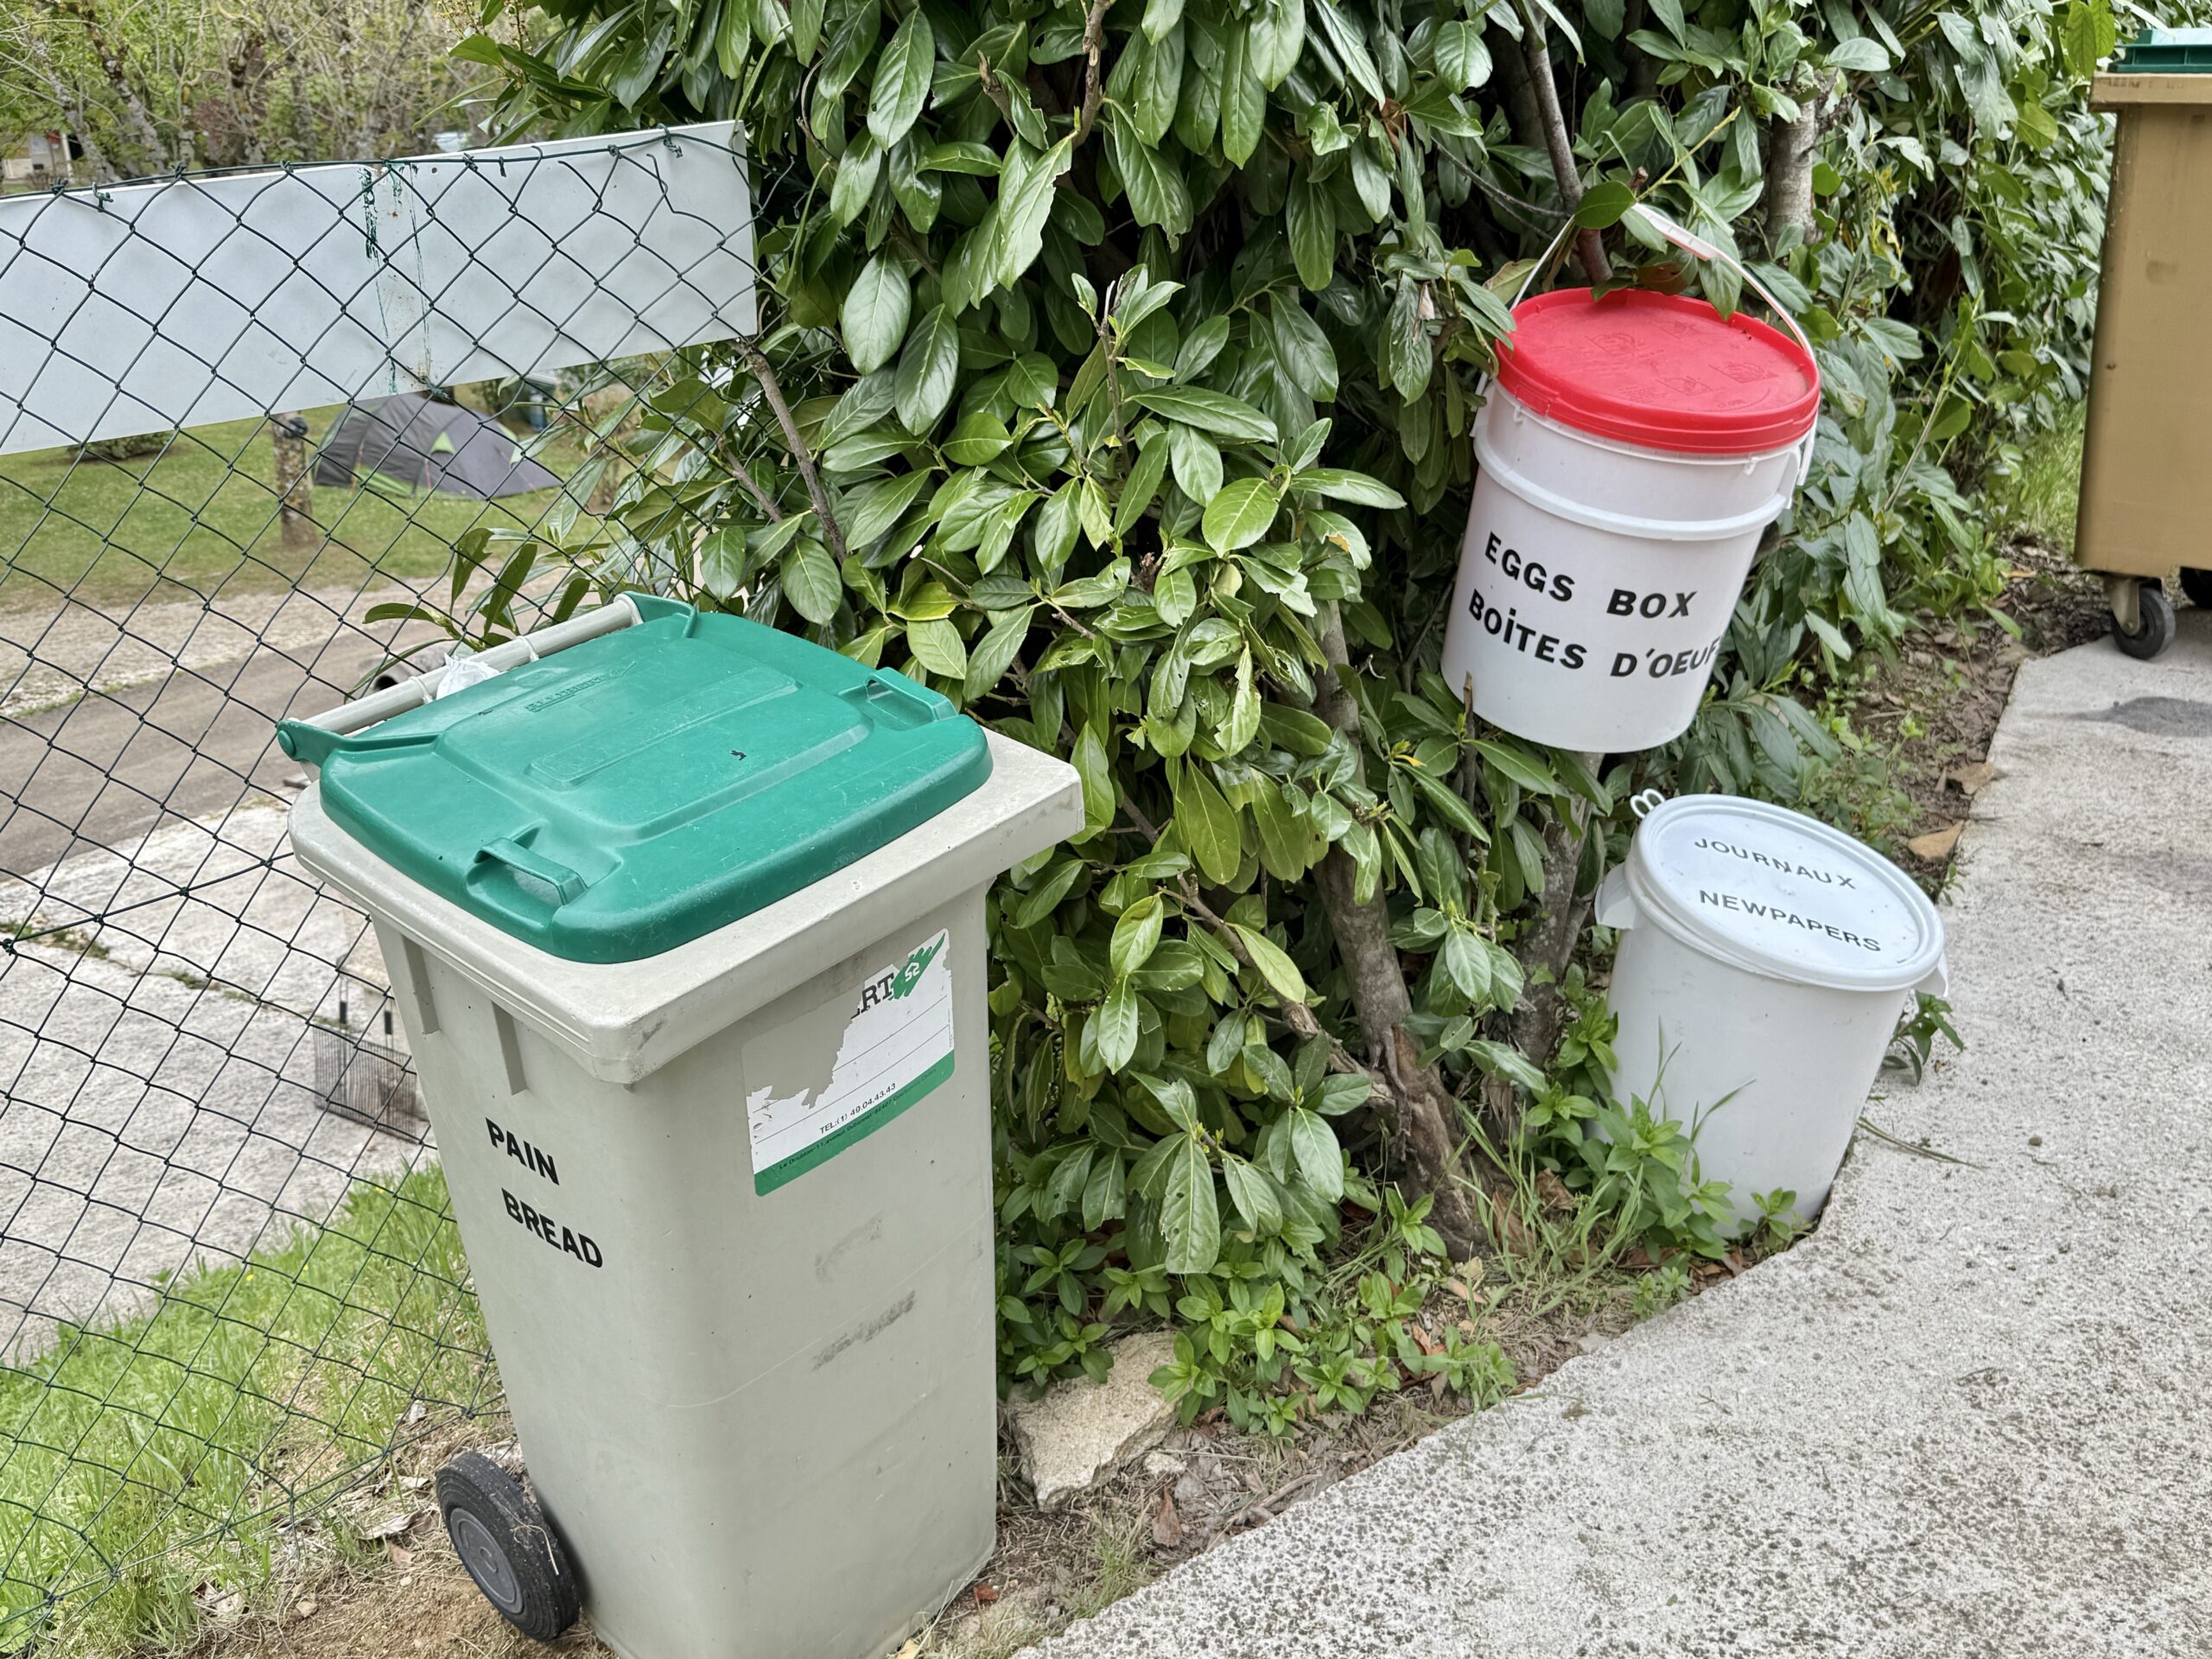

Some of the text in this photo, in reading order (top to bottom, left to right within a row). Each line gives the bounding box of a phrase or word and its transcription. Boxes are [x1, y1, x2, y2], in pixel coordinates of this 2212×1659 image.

[1484, 531, 1698, 619] EGGS BOX
[1610, 635, 1721, 678] D'OEUF
[1694, 838, 1856, 889] JOURNAUX
[1699, 889, 1881, 951] NEWPAPERS
[485, 1116, 560, 1185] PAIN
[501, 1187, 603, 1268] BREAD
